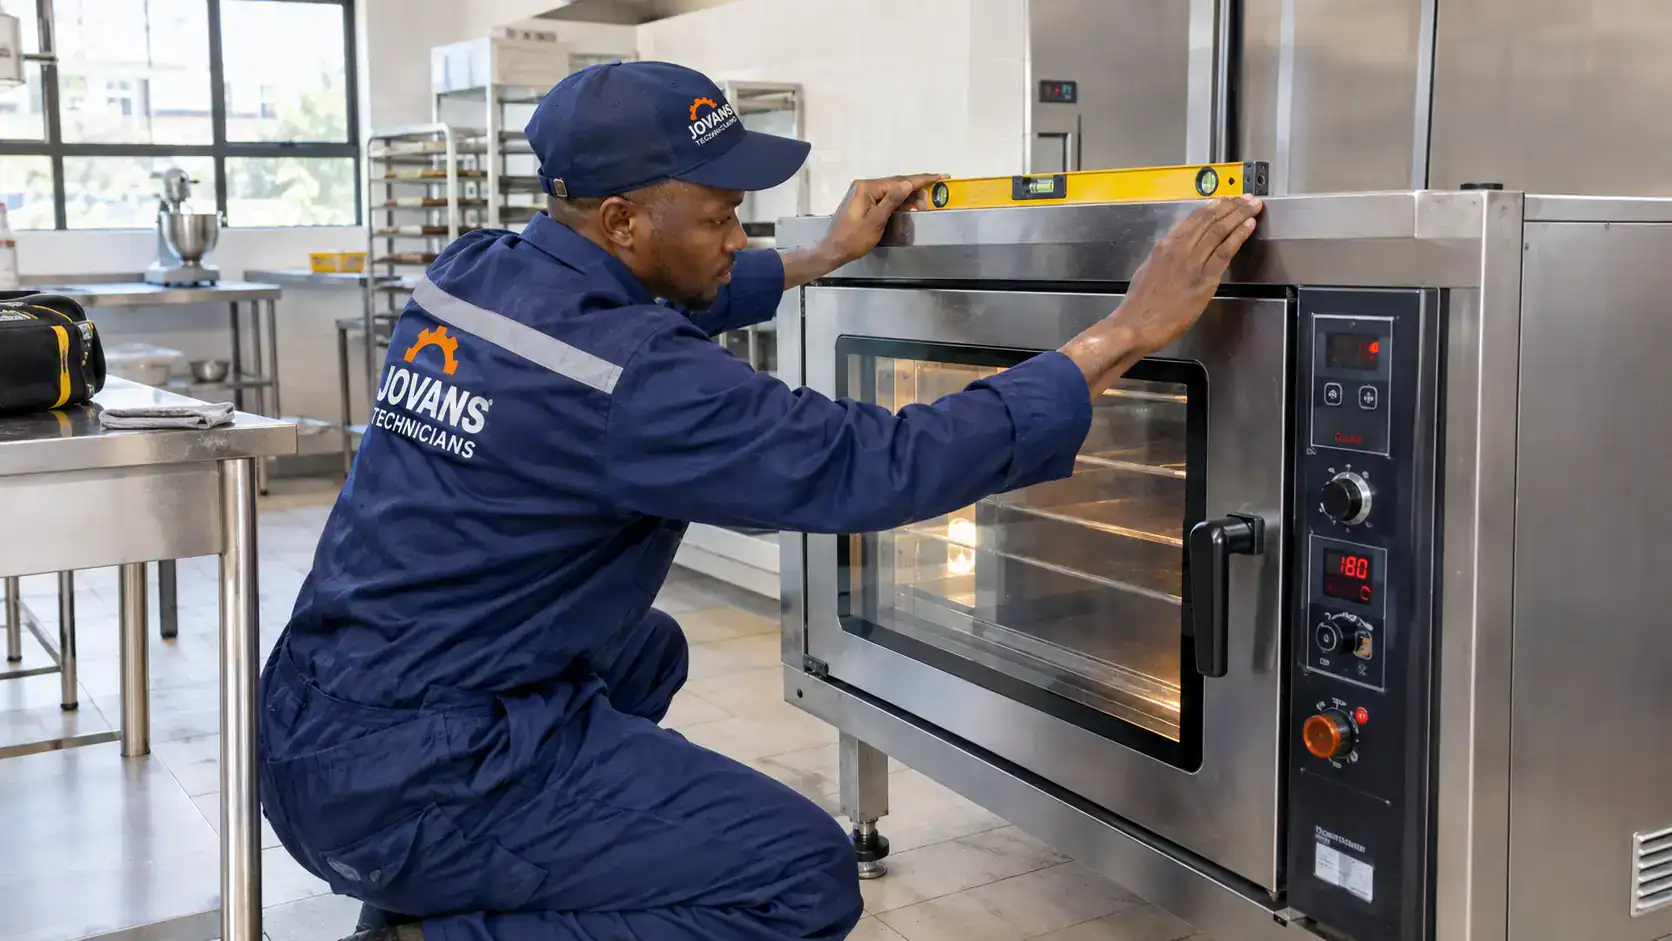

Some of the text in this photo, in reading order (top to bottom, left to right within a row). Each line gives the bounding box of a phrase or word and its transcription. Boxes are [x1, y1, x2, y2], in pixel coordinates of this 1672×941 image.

[688, 103, 733, 140] JOVANS
[376, 365, 489, 434] JOVANS
[371, 407, 476, 459] TECHNICIANS
[1340, 555, 1369, 579] 180
